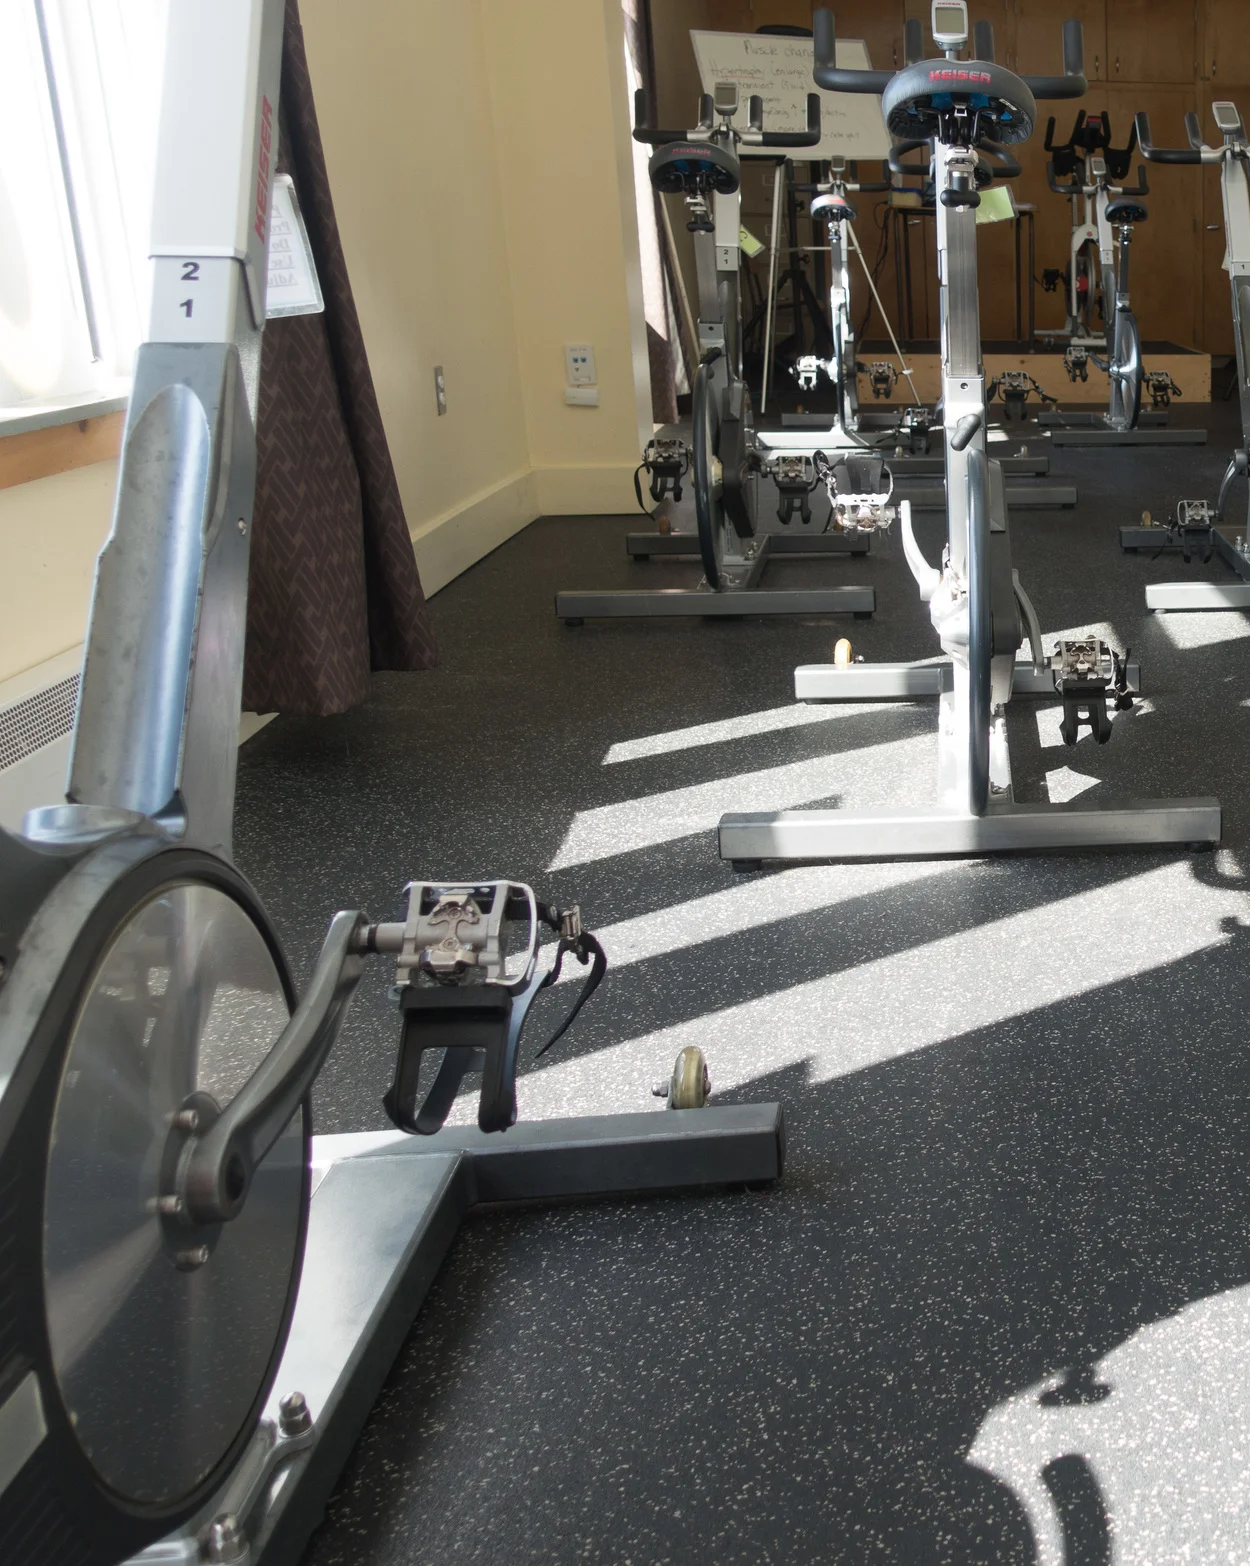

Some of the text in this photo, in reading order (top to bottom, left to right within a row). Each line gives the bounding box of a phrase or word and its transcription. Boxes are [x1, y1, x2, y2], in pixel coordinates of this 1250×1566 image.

[929, 69, 991, 85] KEISER
[672, 147, 711, 156] KEISER
[255, 95, 273, 245] KEISER
[181, 262, 200, 281] 2
[180, 299, 193, 318] 1
